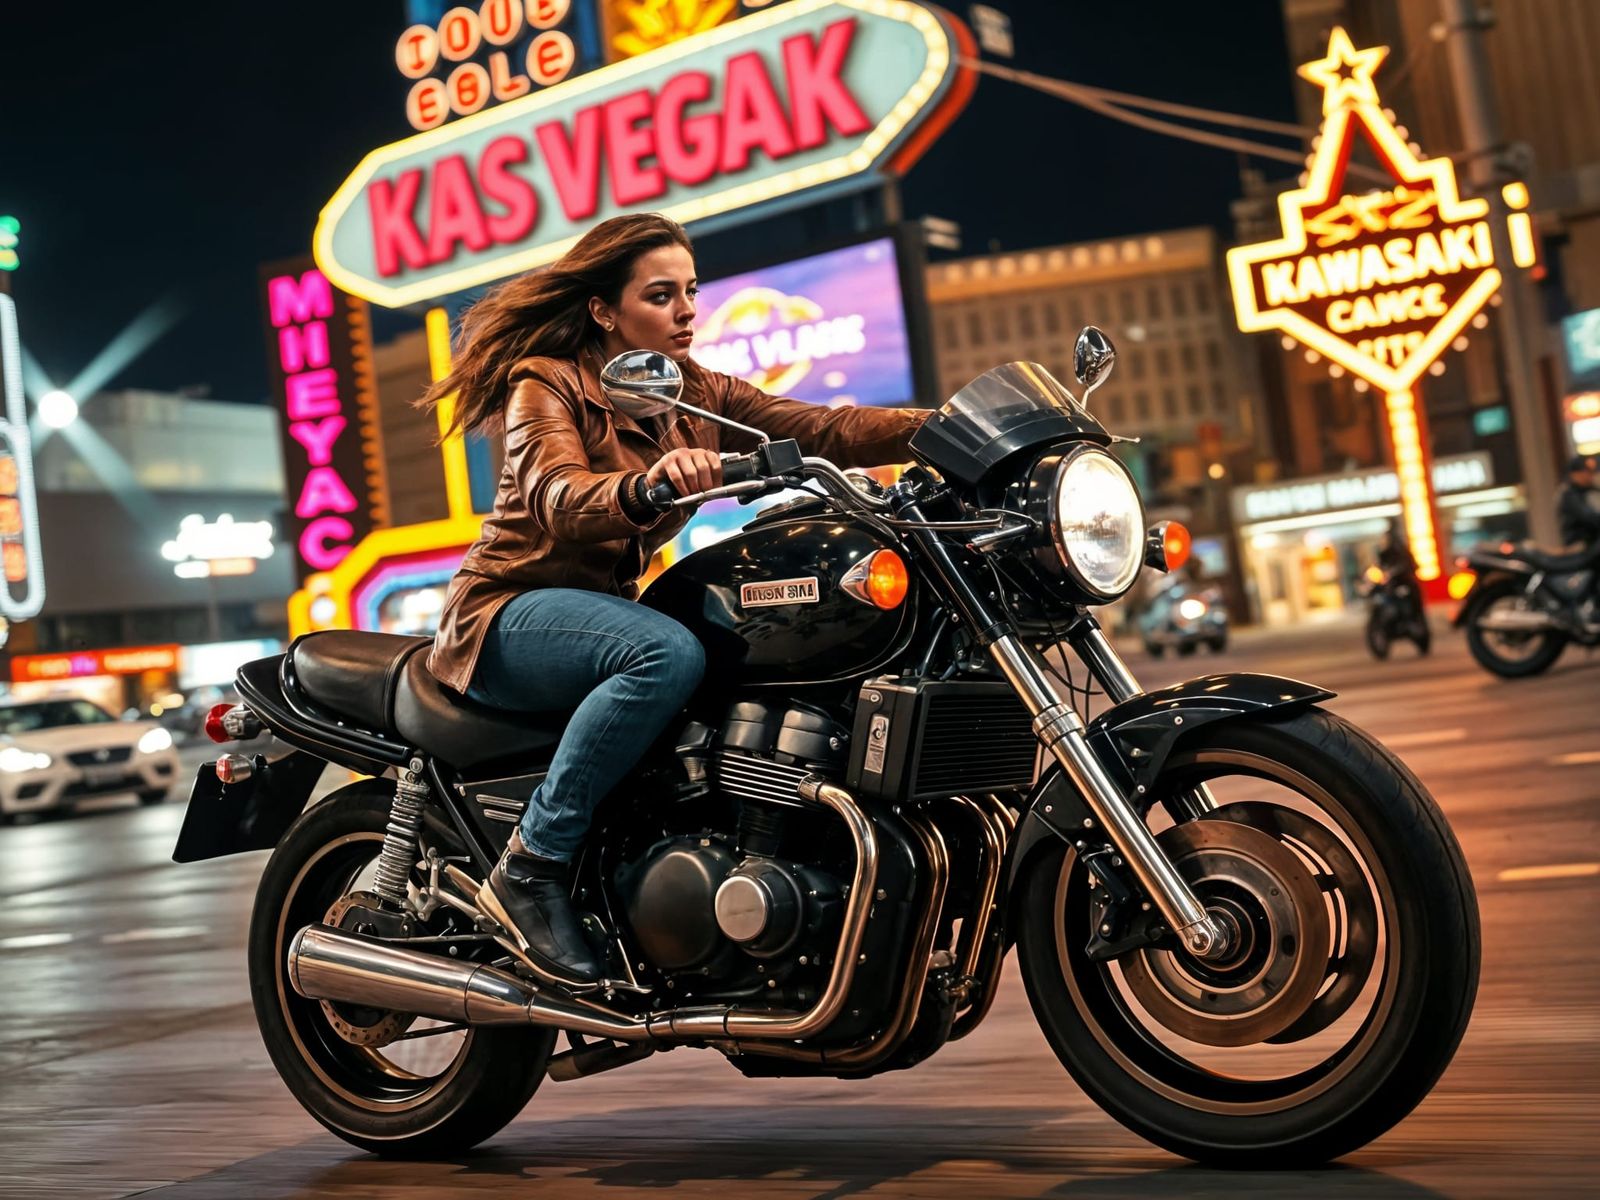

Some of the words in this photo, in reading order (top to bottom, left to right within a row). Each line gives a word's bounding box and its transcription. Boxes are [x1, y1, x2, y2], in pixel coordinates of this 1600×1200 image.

[366, 135, 540, 278] KAS
[534, 16, 871, 222] VEGAK
[1261, 221, 1494, 307] KAWASAKI
